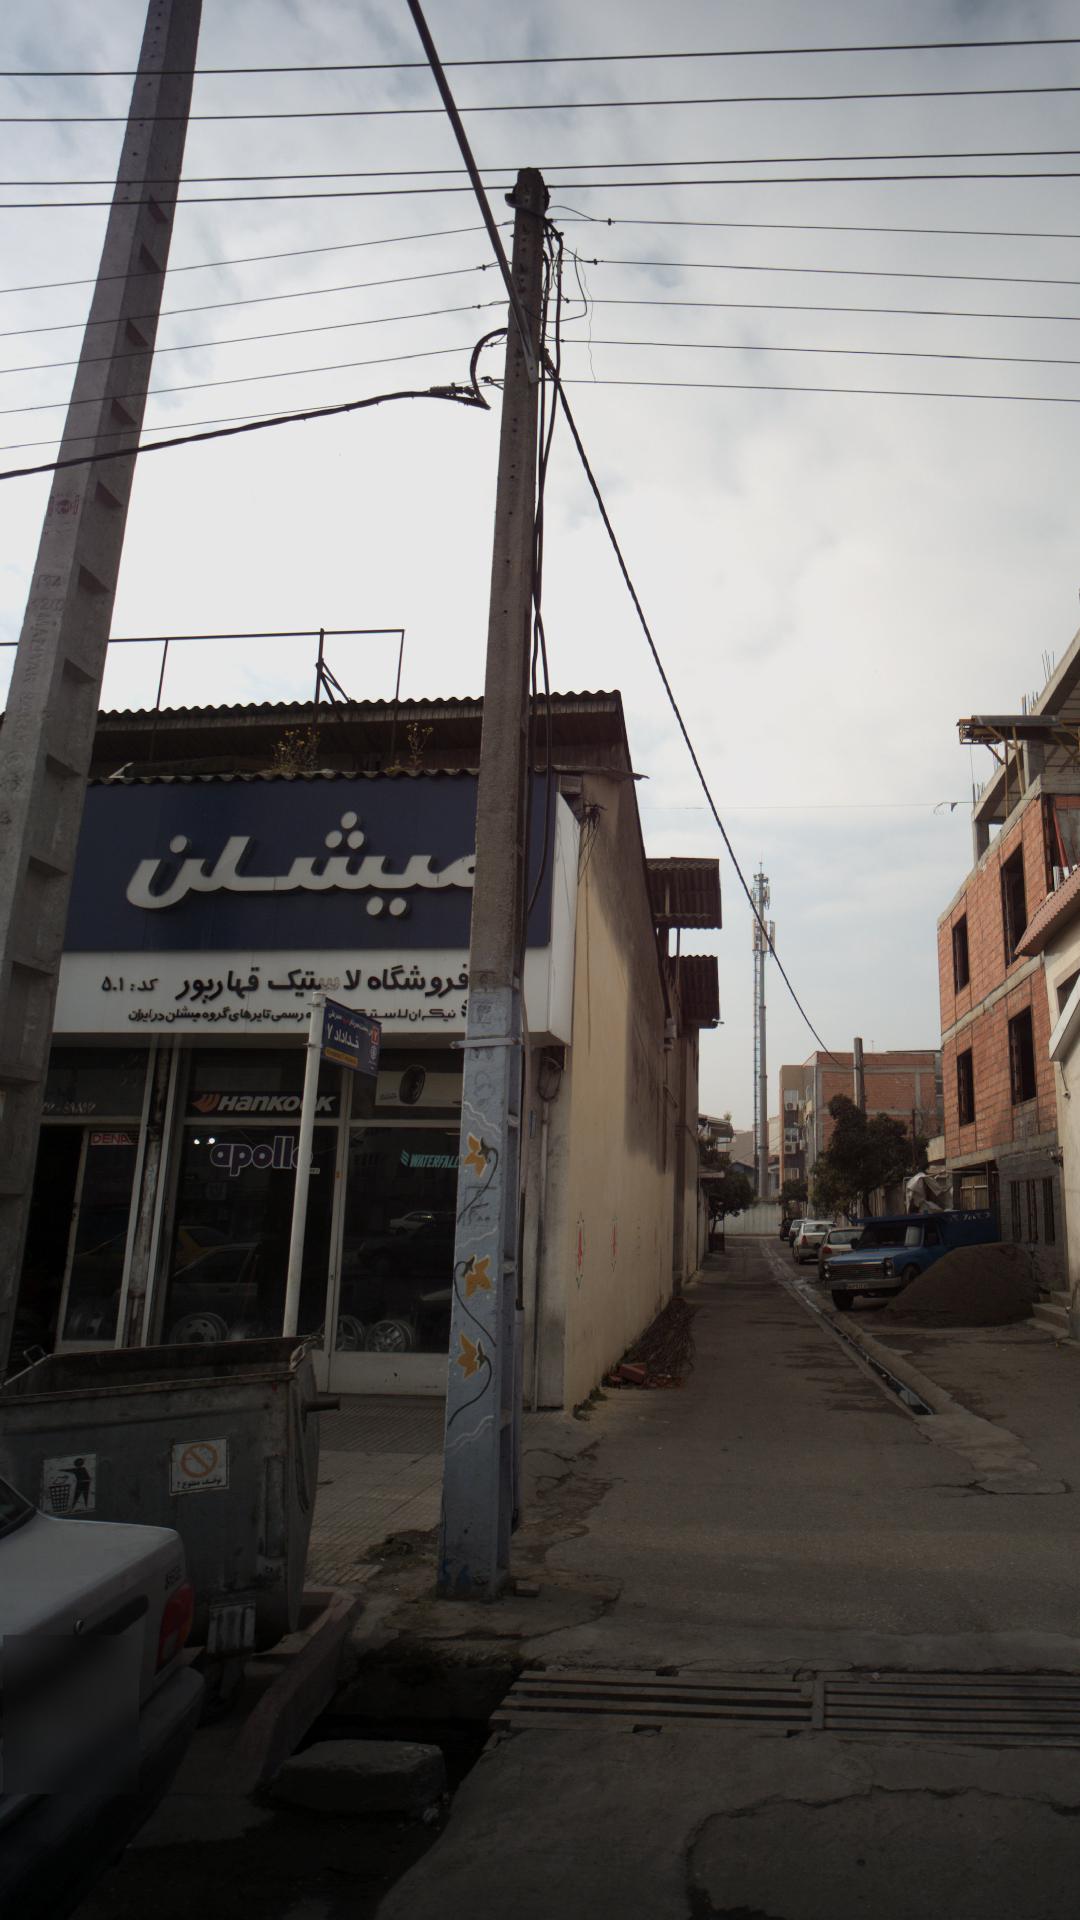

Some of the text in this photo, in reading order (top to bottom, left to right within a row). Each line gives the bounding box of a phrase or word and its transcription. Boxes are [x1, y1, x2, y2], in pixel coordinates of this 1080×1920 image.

[126, 810, 476, 917] میشلن
[367, 963, 469, 997] فروشگاه
[165, 1006, 201, 1022] میشلن
[202, 1006, 230, 1021] گروه
[271, 1009, 304, 1022] رسمی
